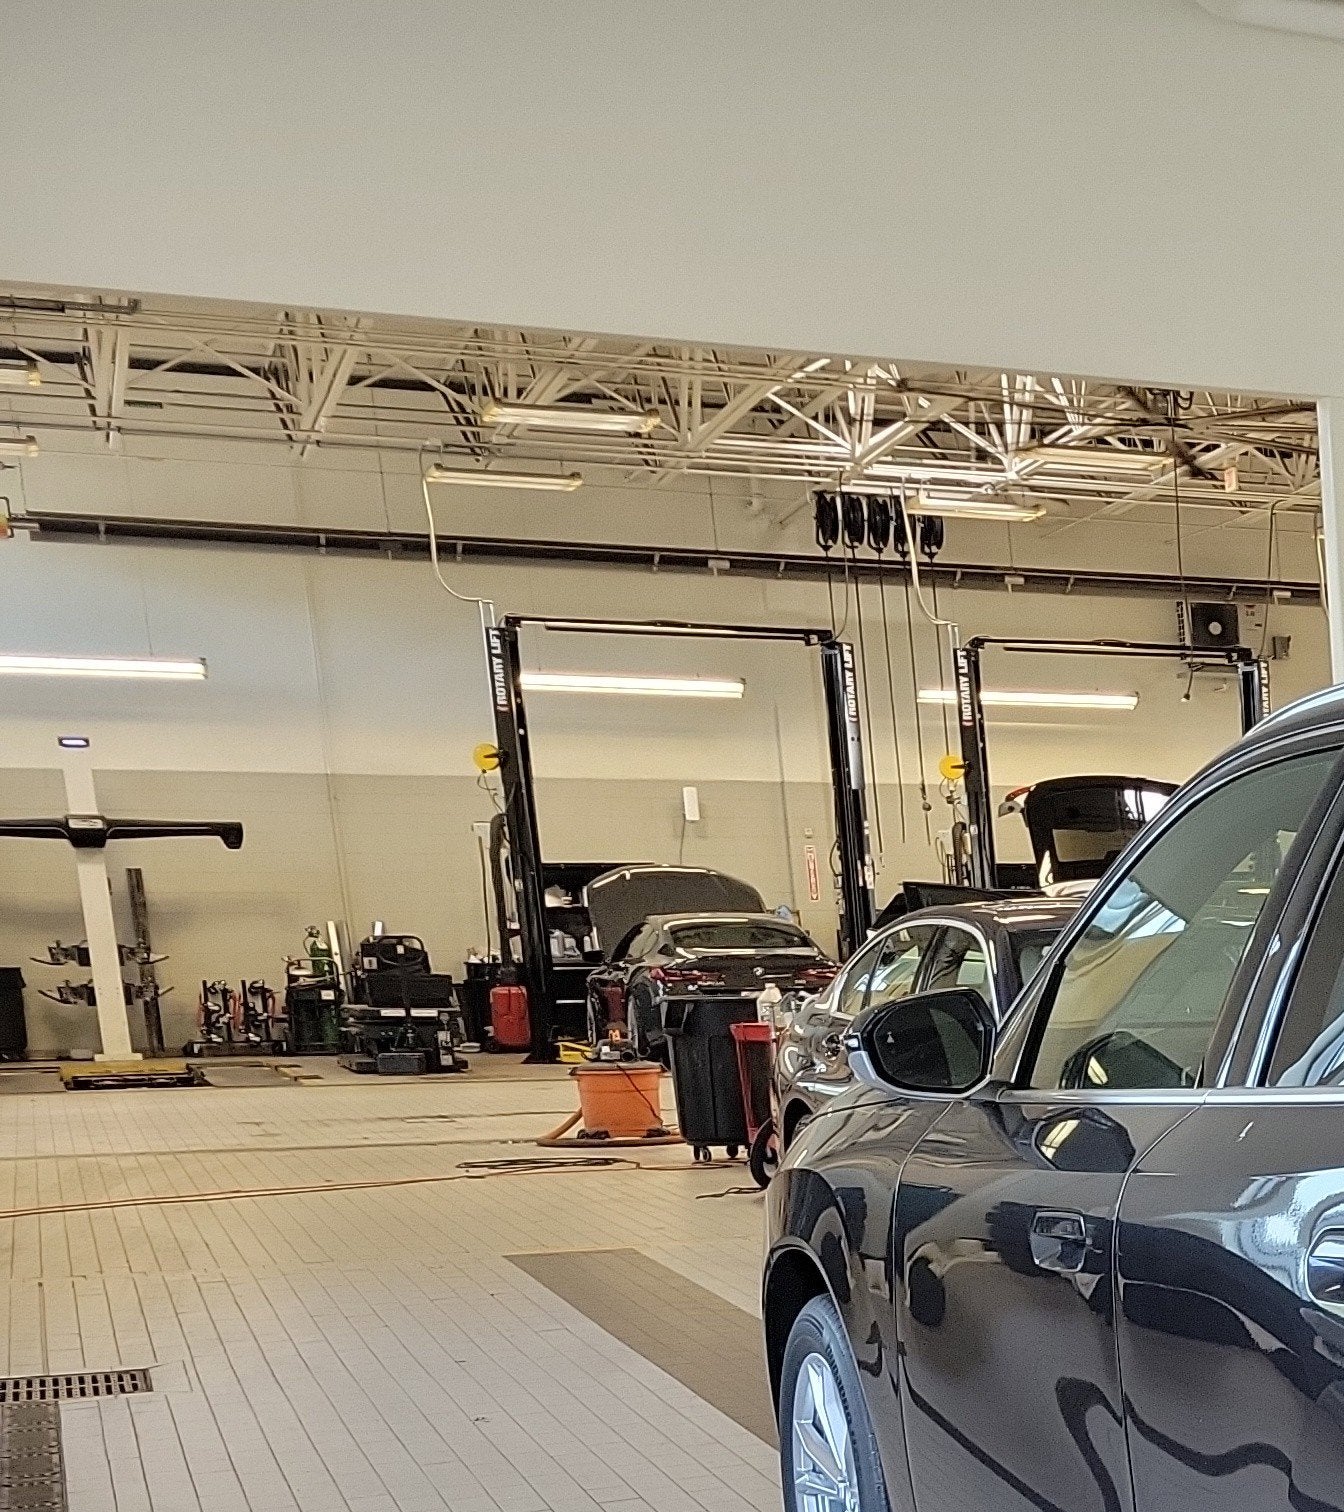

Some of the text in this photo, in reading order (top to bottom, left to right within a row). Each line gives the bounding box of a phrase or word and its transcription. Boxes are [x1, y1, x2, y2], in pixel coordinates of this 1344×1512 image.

[488, 628, 509, 705] ROTARY LIFT
[845, 670, 858, 717] ROTARY
[956, 649, 973, 720] ROTARY LIFT
